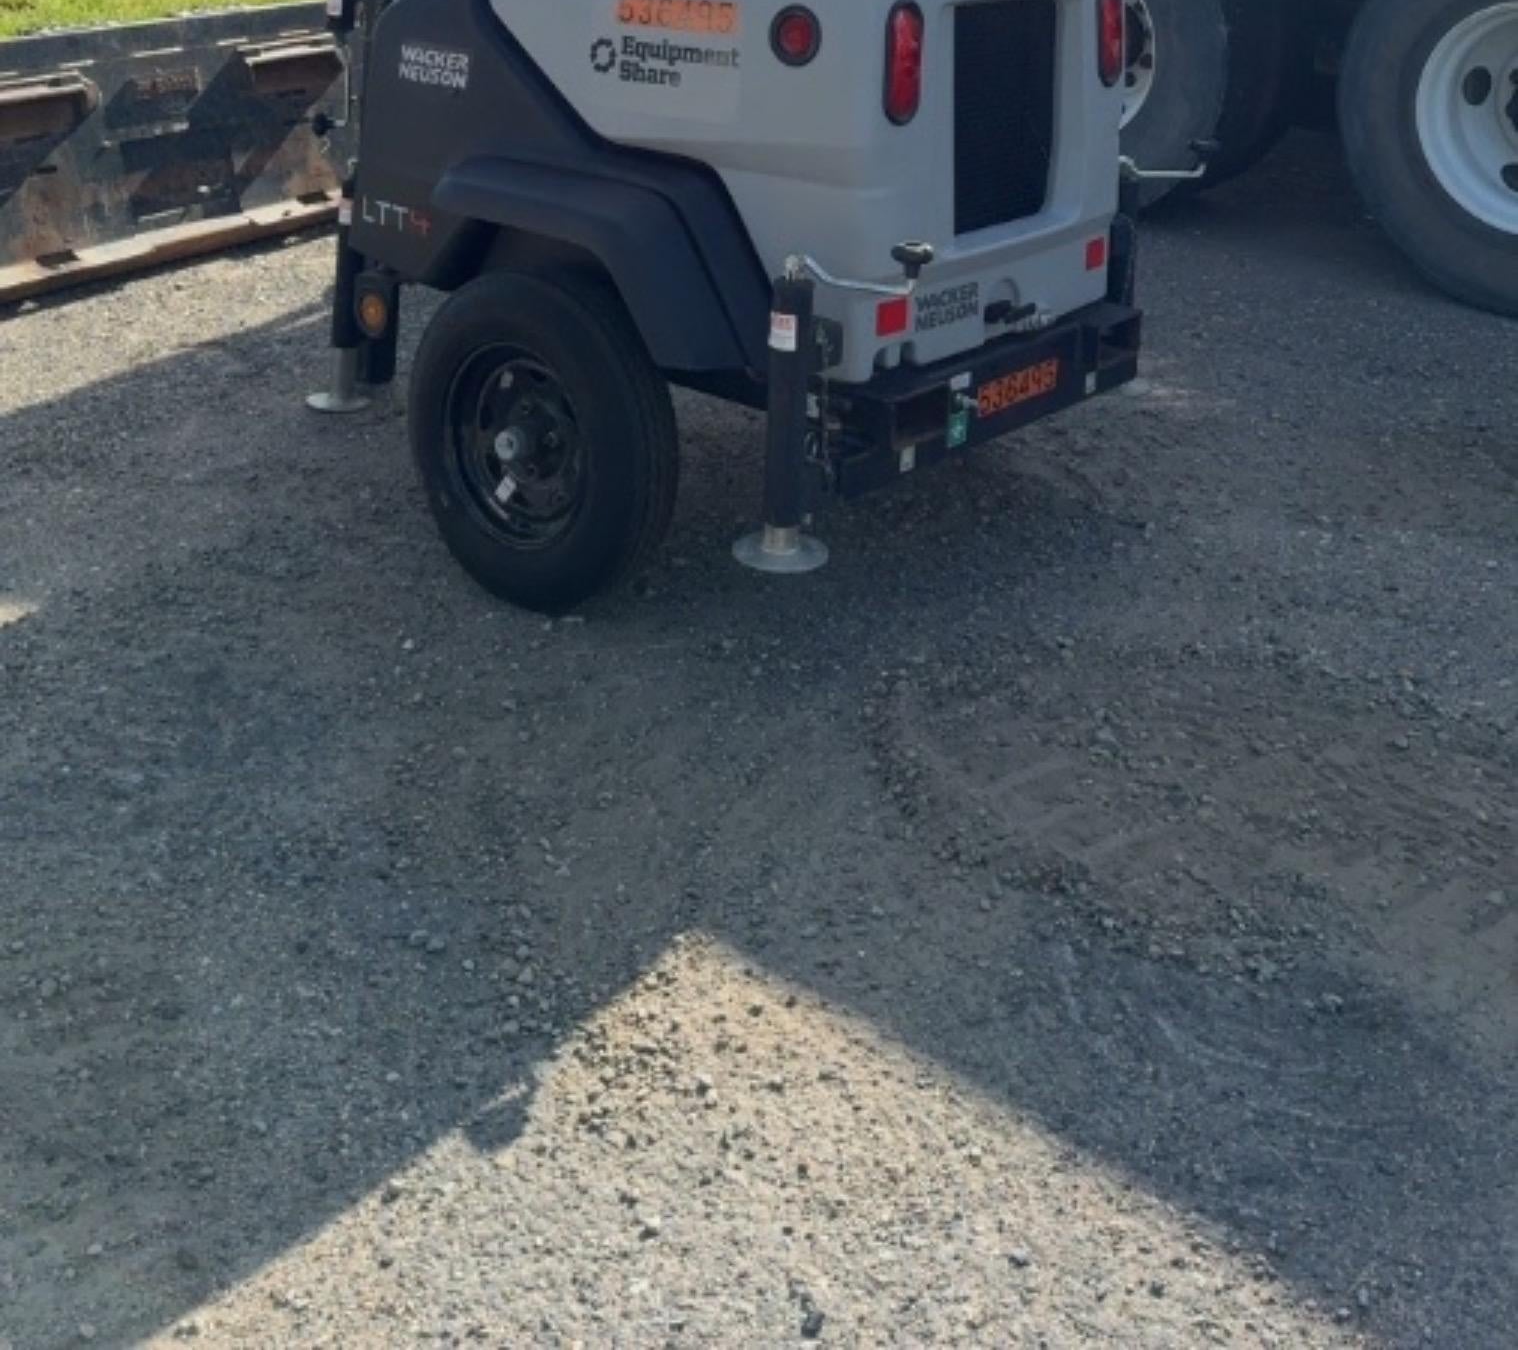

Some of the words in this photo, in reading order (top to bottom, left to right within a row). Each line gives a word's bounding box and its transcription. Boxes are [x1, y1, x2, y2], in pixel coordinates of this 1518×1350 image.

[400, 43, 469, 73] WACKER
[620, 35, 740, 68] Equipment
[398, 62, 467, 88] NEUSON
[618, 59, 682, 87] Share
[361, 194, 432, 237] LTT4
[914, 281, 979, 312] WACKER
[914, 301, 978, 332] NEUSON
